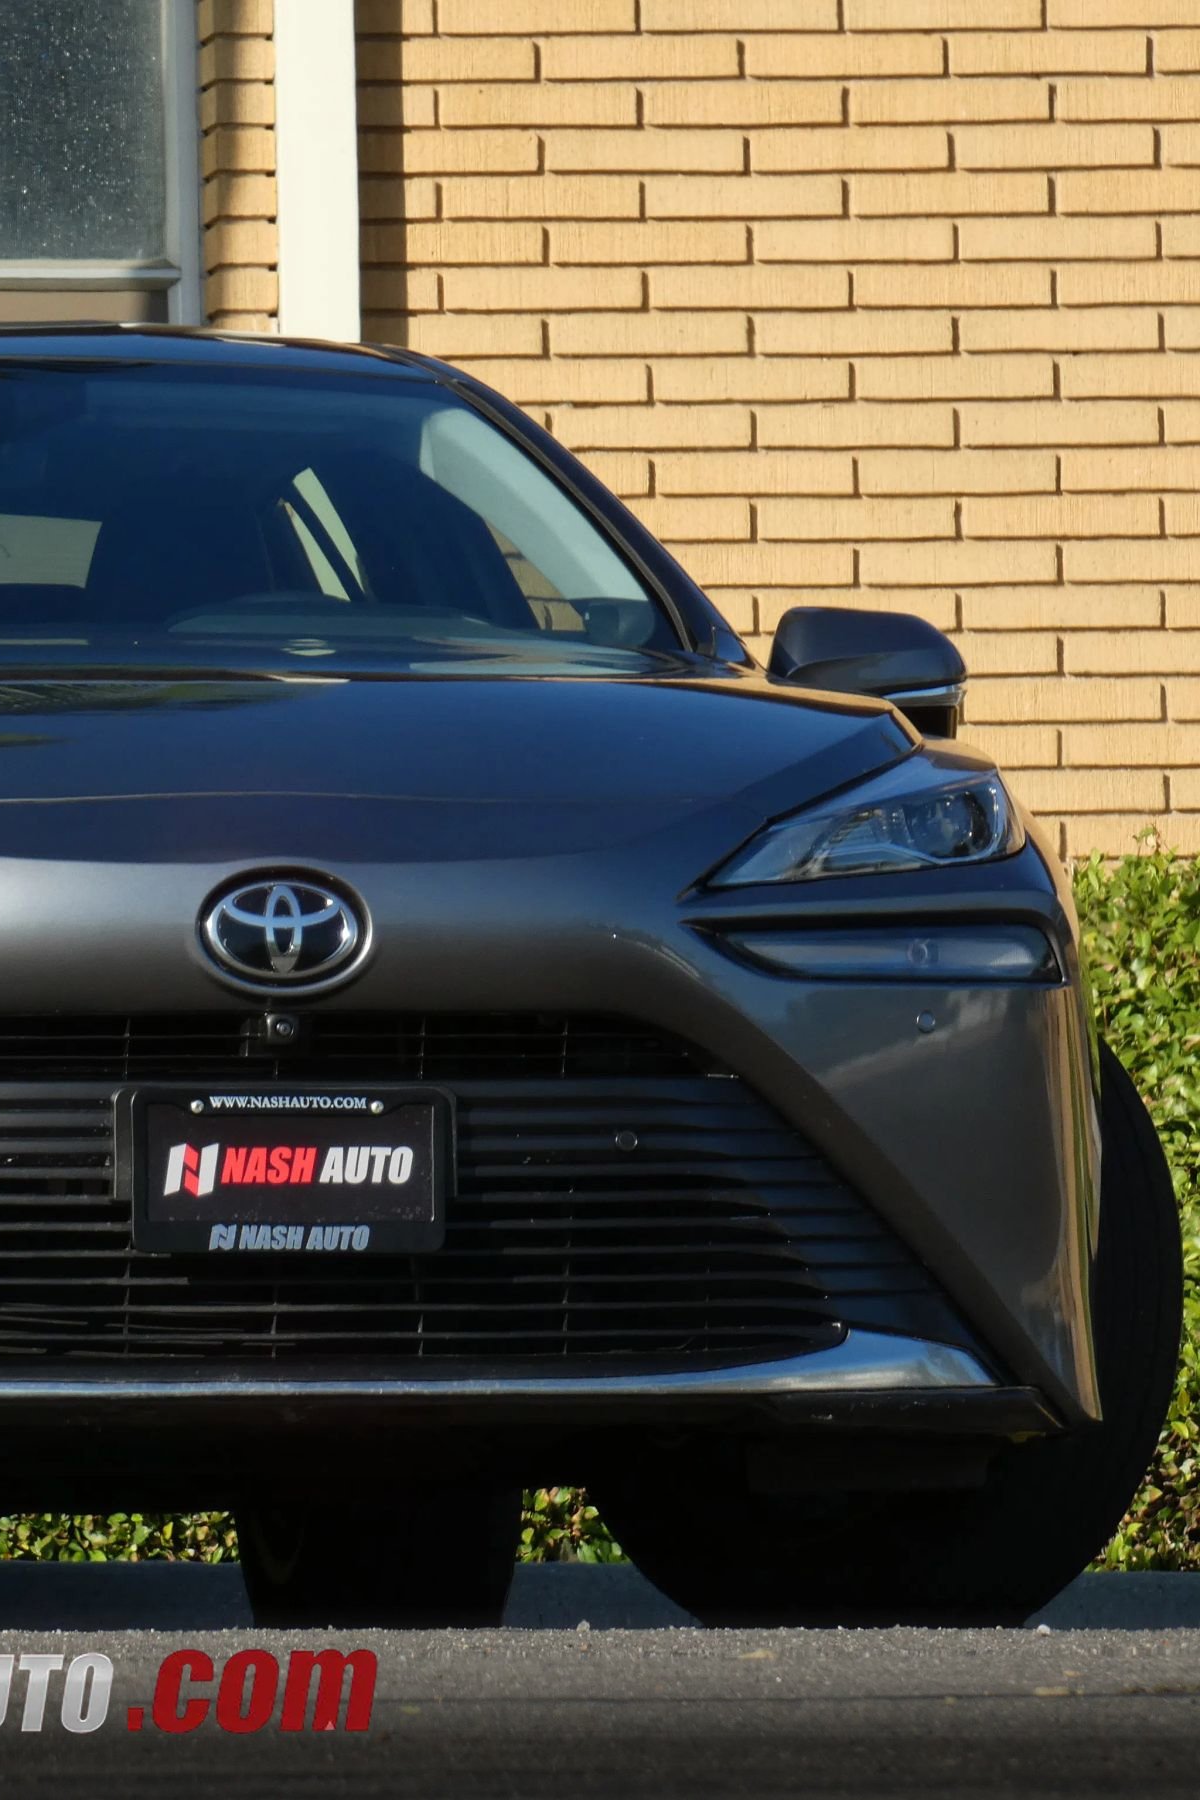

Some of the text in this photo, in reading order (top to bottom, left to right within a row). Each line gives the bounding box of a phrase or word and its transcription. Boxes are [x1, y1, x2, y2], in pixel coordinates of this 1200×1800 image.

[209, 1096, 367, 1110] WWW.NASHAUTO.COM
[220, 1146, 318, 1185] NASH
[319, 1145, 415, 1185] AUTO
[238, 1224, 305, 1251] NASH
[305, 1224, 371, 1251] AUTO
